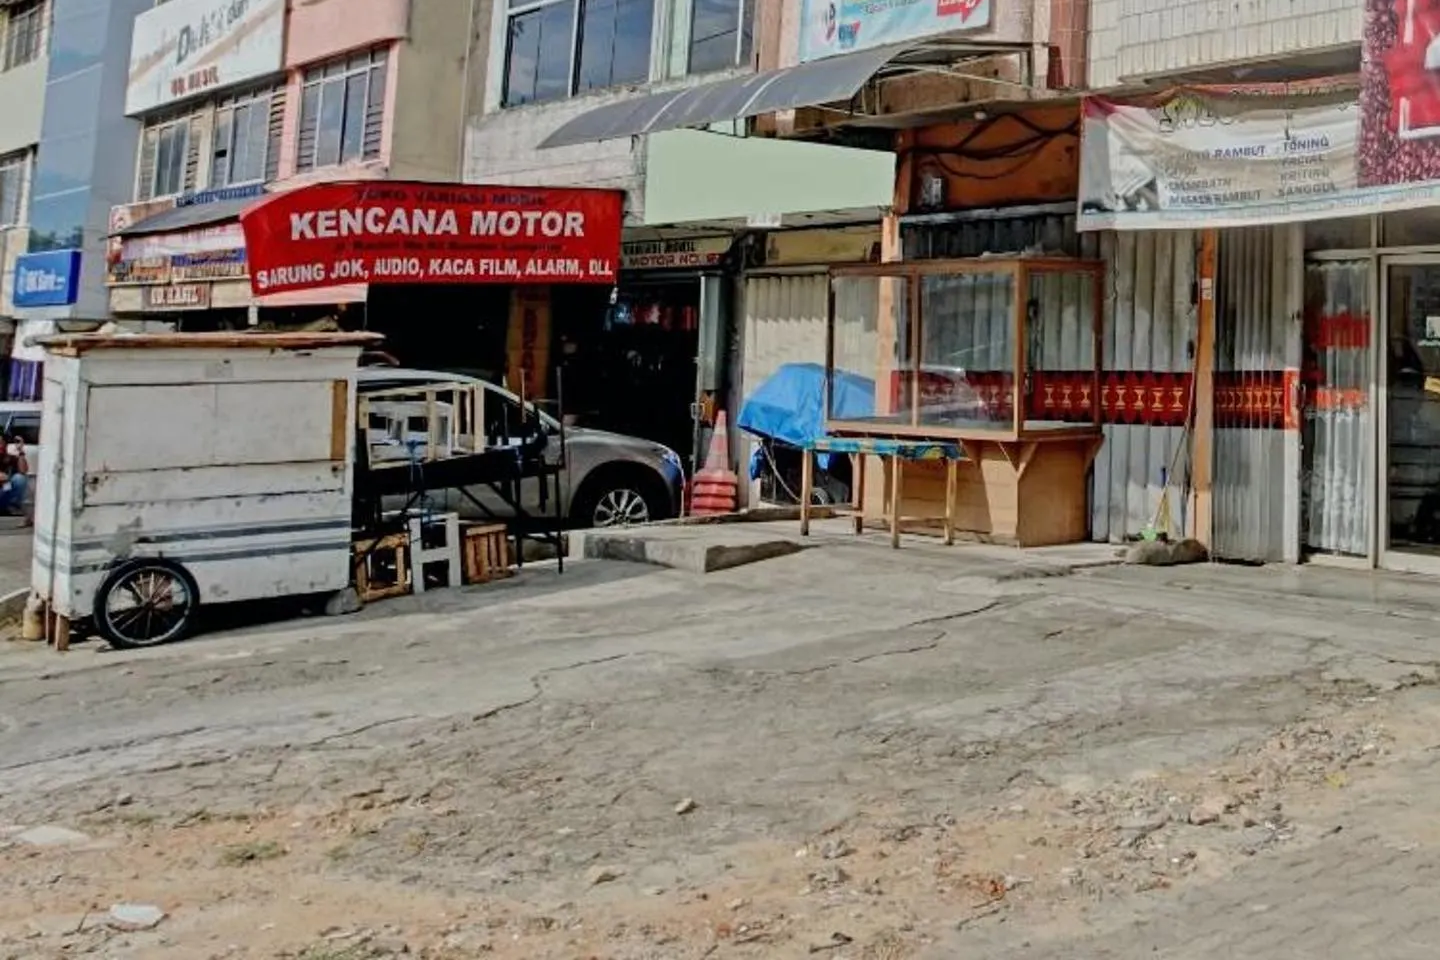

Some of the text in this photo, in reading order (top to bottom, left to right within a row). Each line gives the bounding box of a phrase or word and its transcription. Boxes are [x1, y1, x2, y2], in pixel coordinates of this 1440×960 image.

[289, 206, 585, 241] KENCANA MOTOR
[256, 262, 326, 289] SARUNG
[329, 258, 370, 281] JOK,
[374, 256, 424, 279] AUDIO,
[428, 258, 476, 276] KACA
[479, 258, 522, 279] FILM,
[524, 258, 585, 279] ALARM,
[588, 258, 613, 276] DLL
